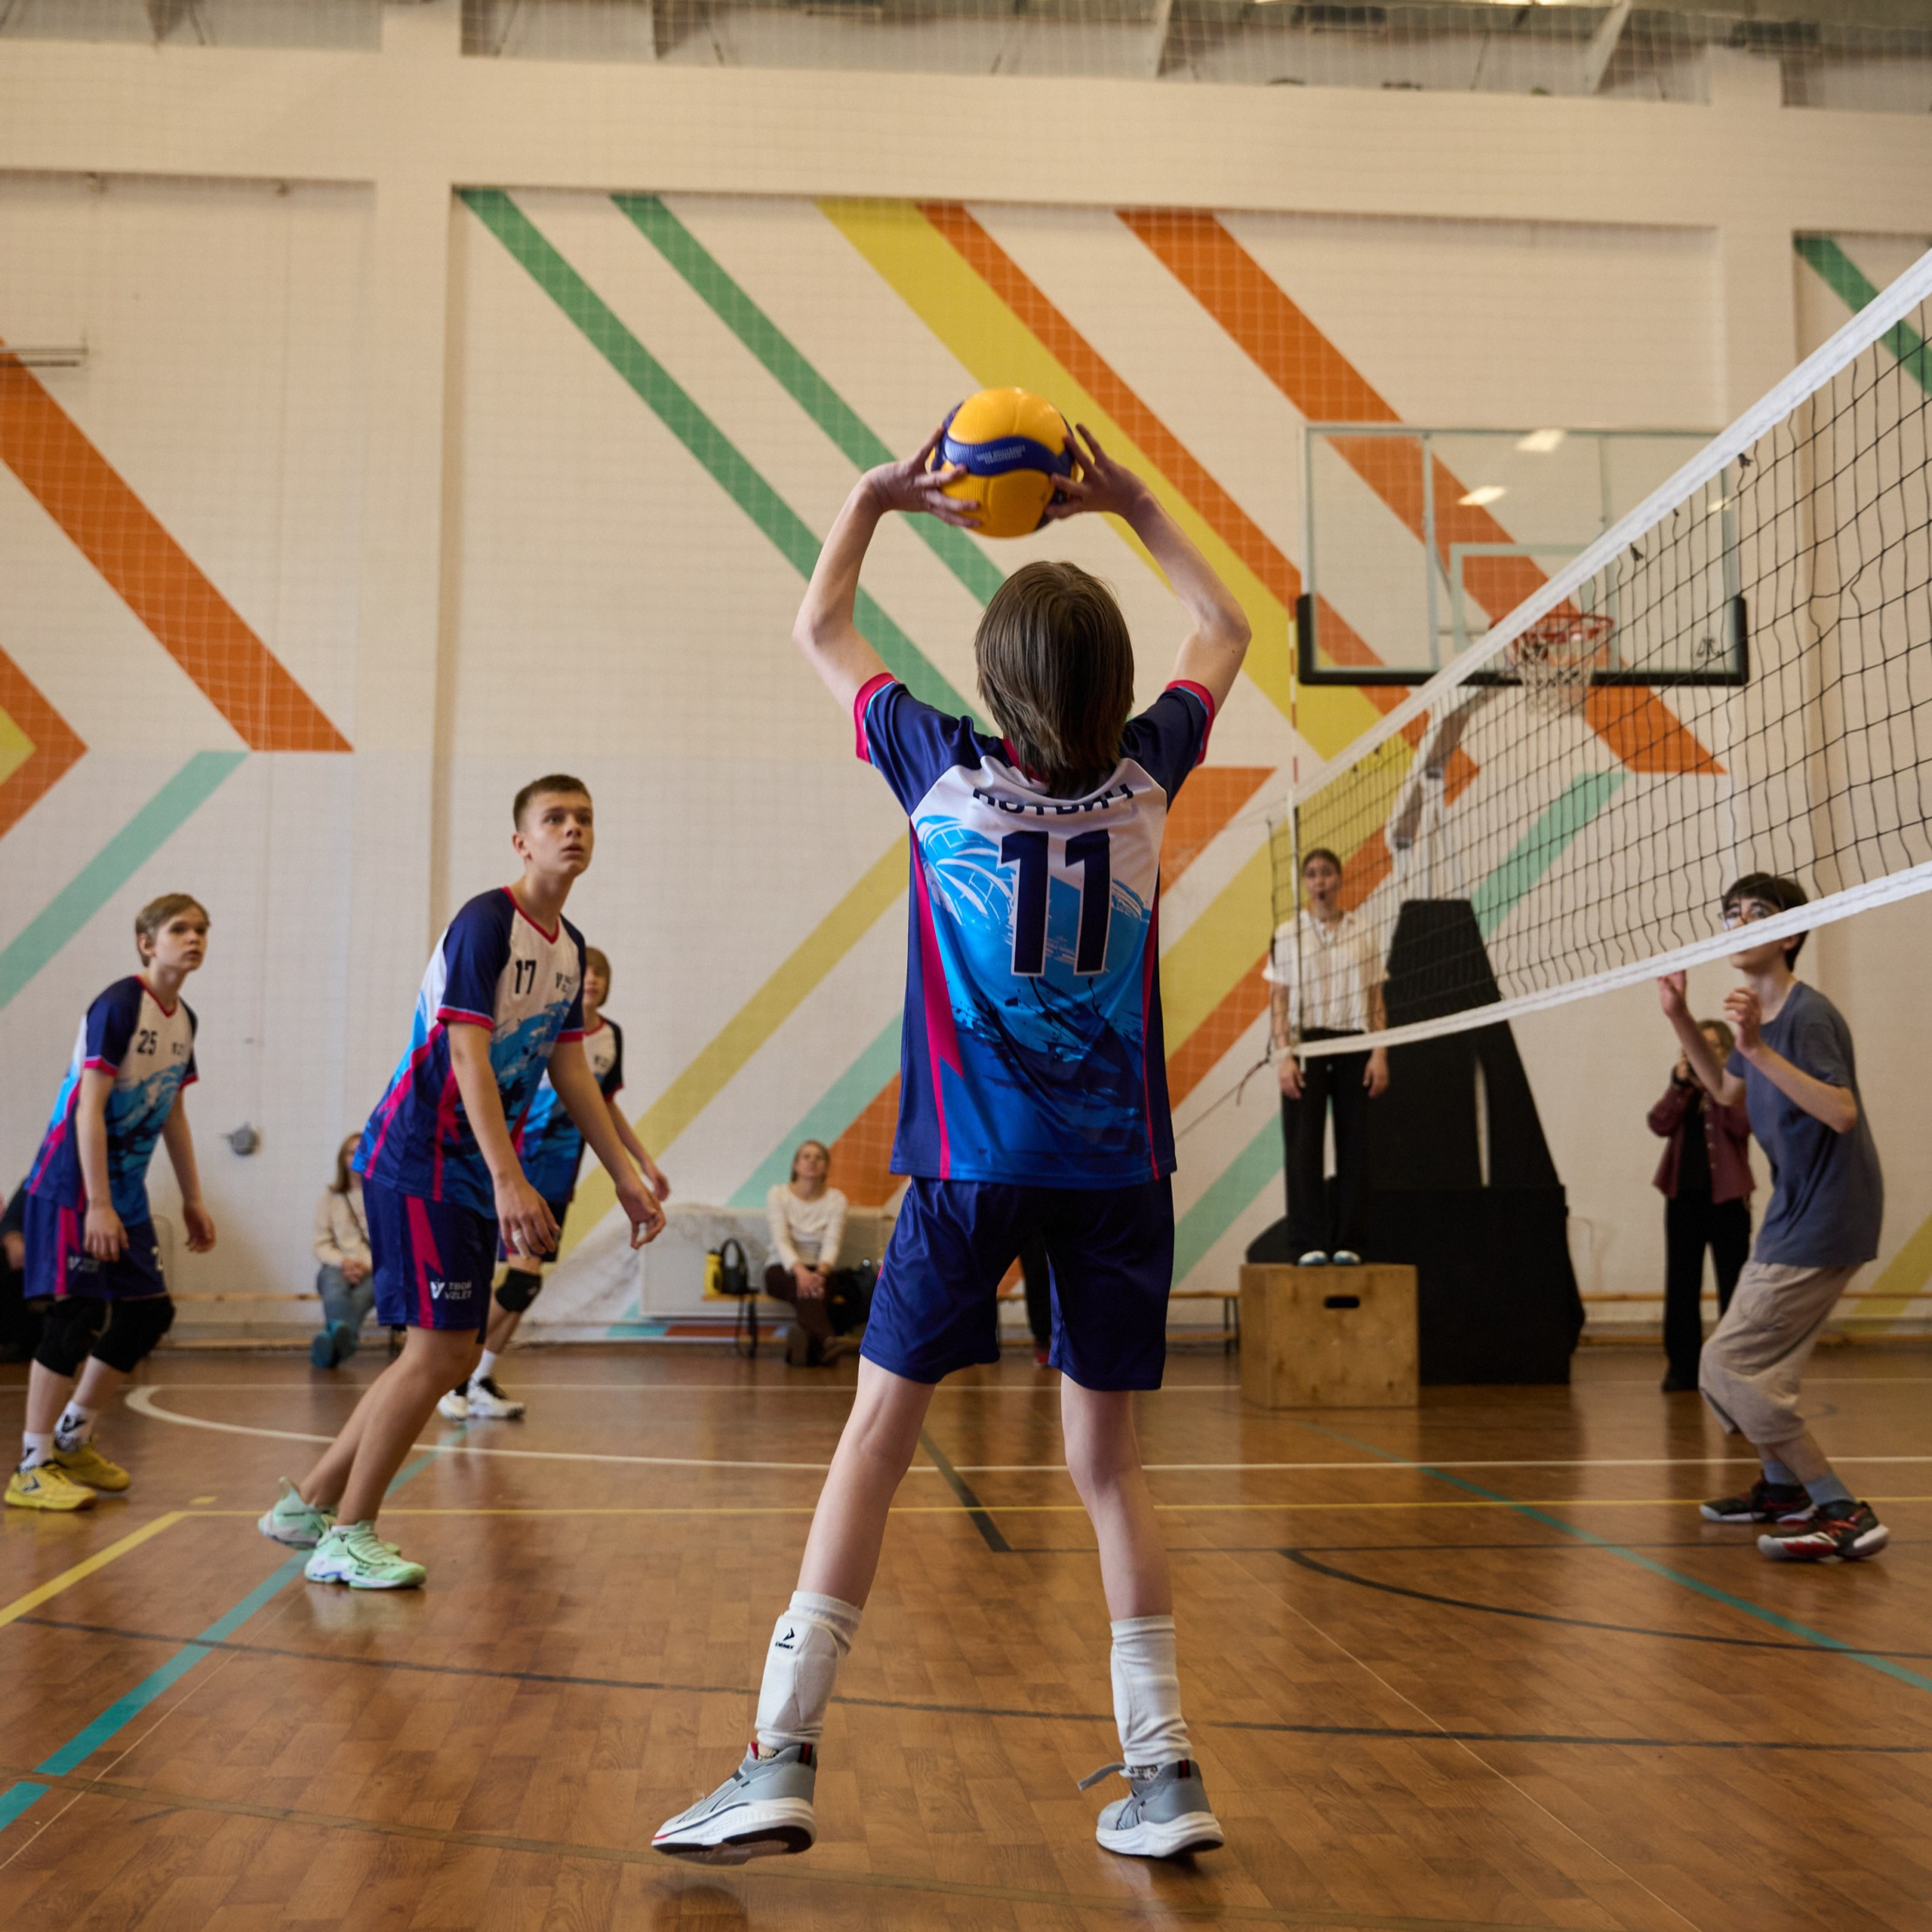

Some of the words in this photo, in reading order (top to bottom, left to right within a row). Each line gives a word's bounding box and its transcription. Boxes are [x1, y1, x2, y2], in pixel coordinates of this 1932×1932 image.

[999, 828, 1111, 974] 11
[515, 958, 537, 995] 17
[137, 1029, 158, 1055] 25
